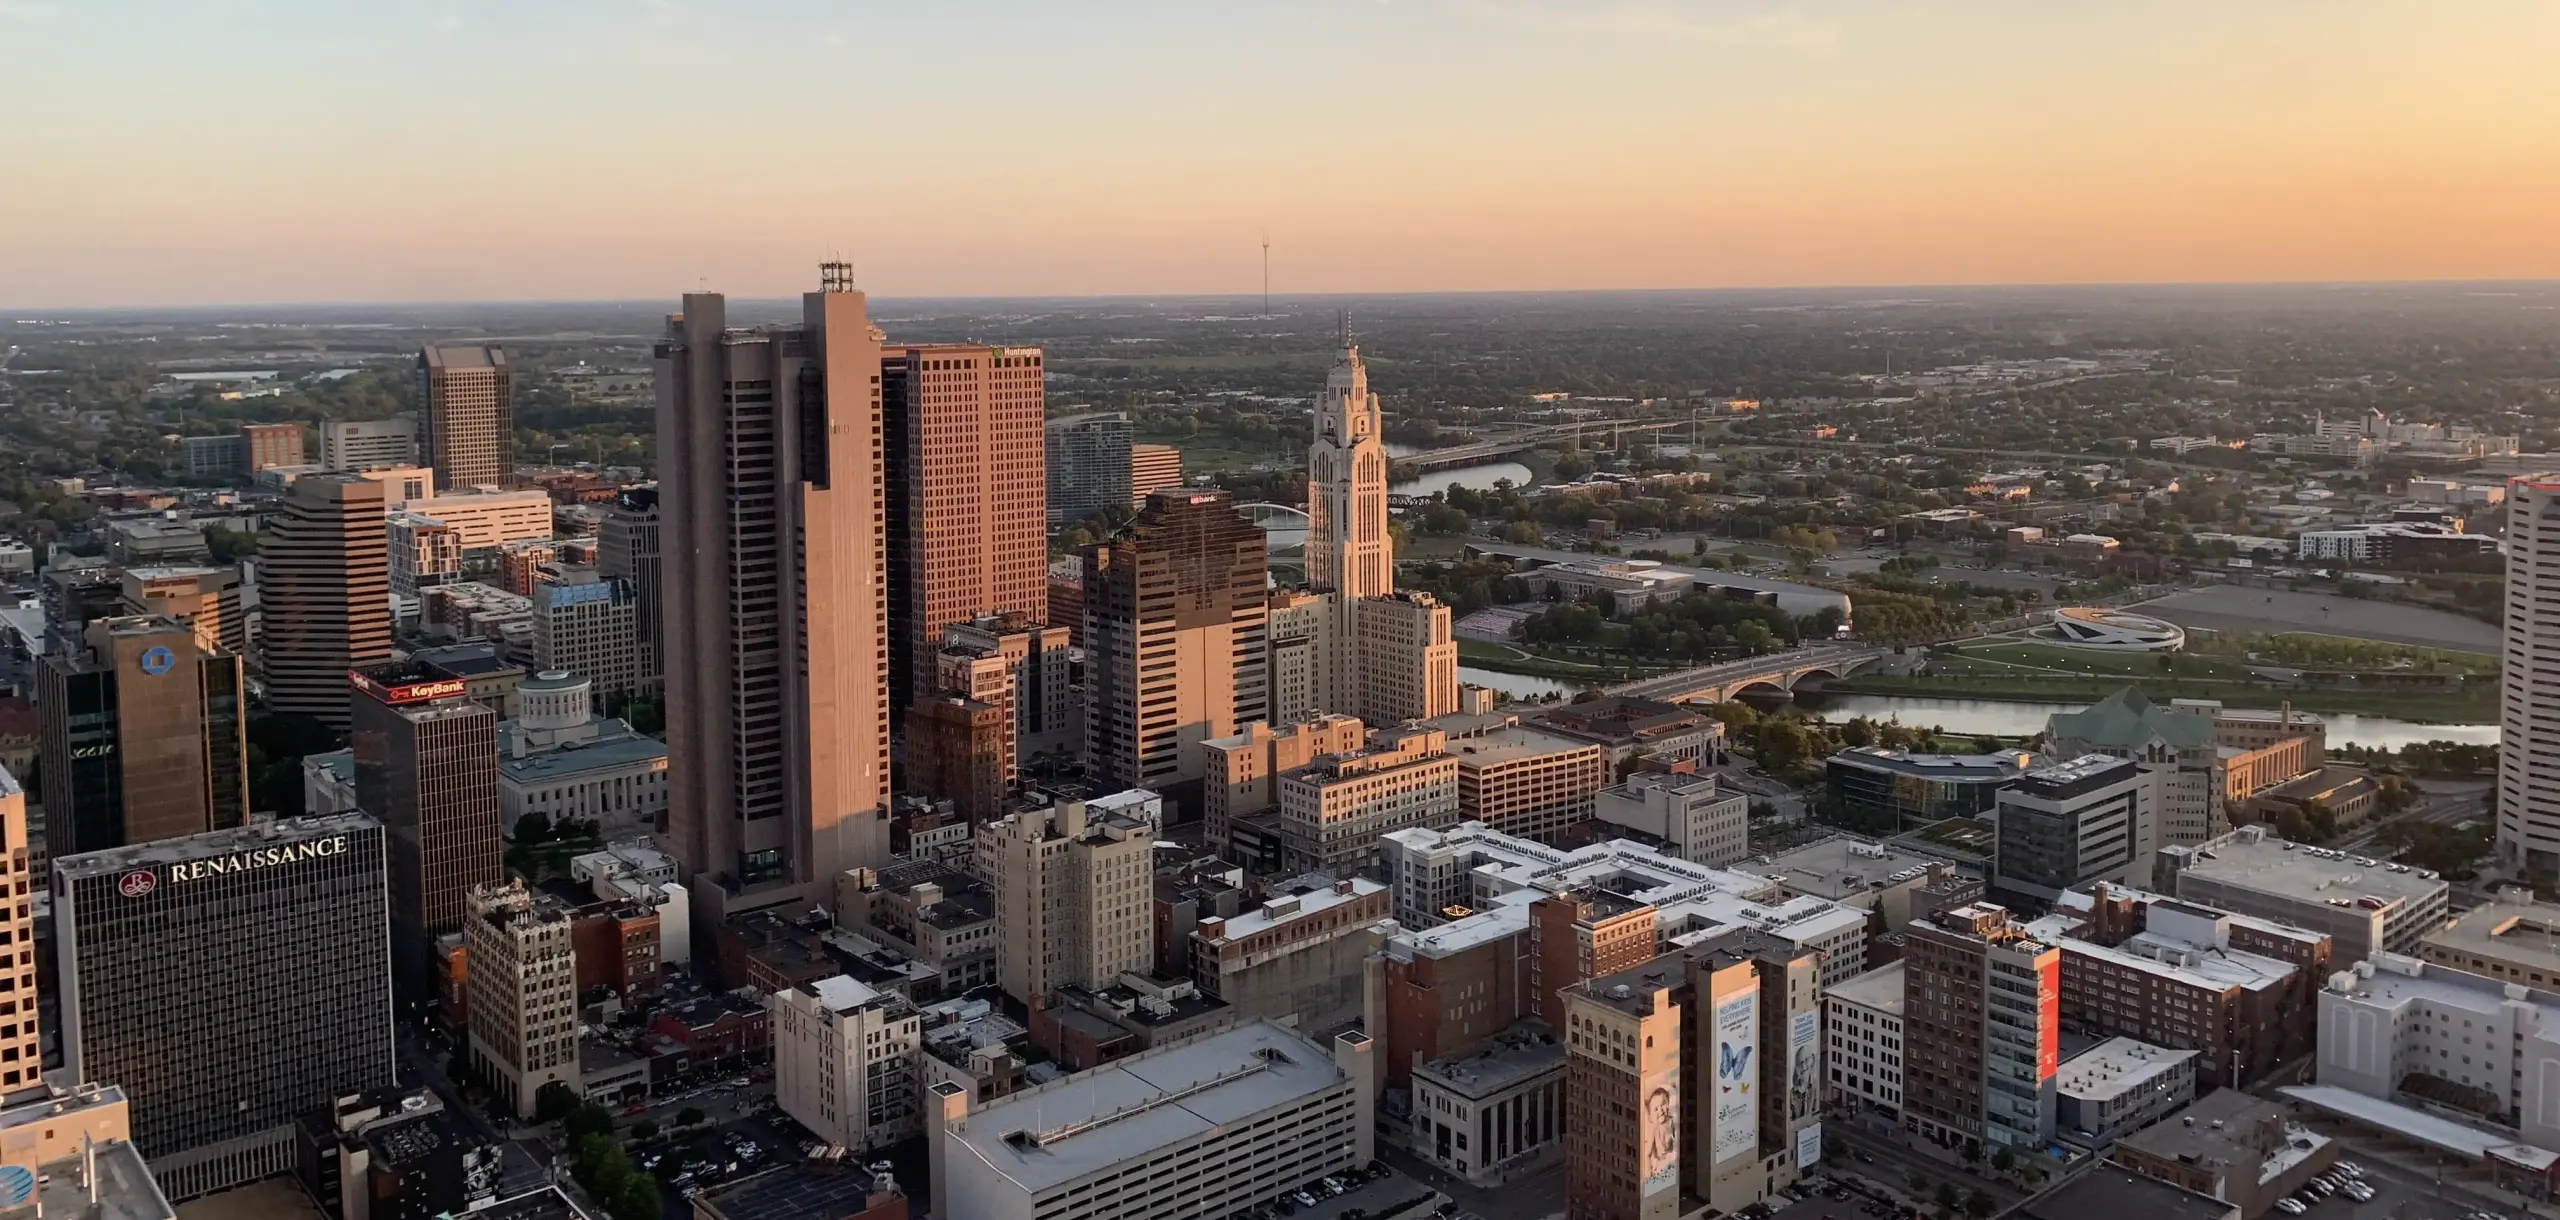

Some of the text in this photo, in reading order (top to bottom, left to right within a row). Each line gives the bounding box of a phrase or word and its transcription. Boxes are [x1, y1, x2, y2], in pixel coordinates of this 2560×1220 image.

[1004, 347, 1041, 358] Huntington
[411, 681, 465, 698] KeyBank
[171, 836, 348, 884] RENAISSANCE
